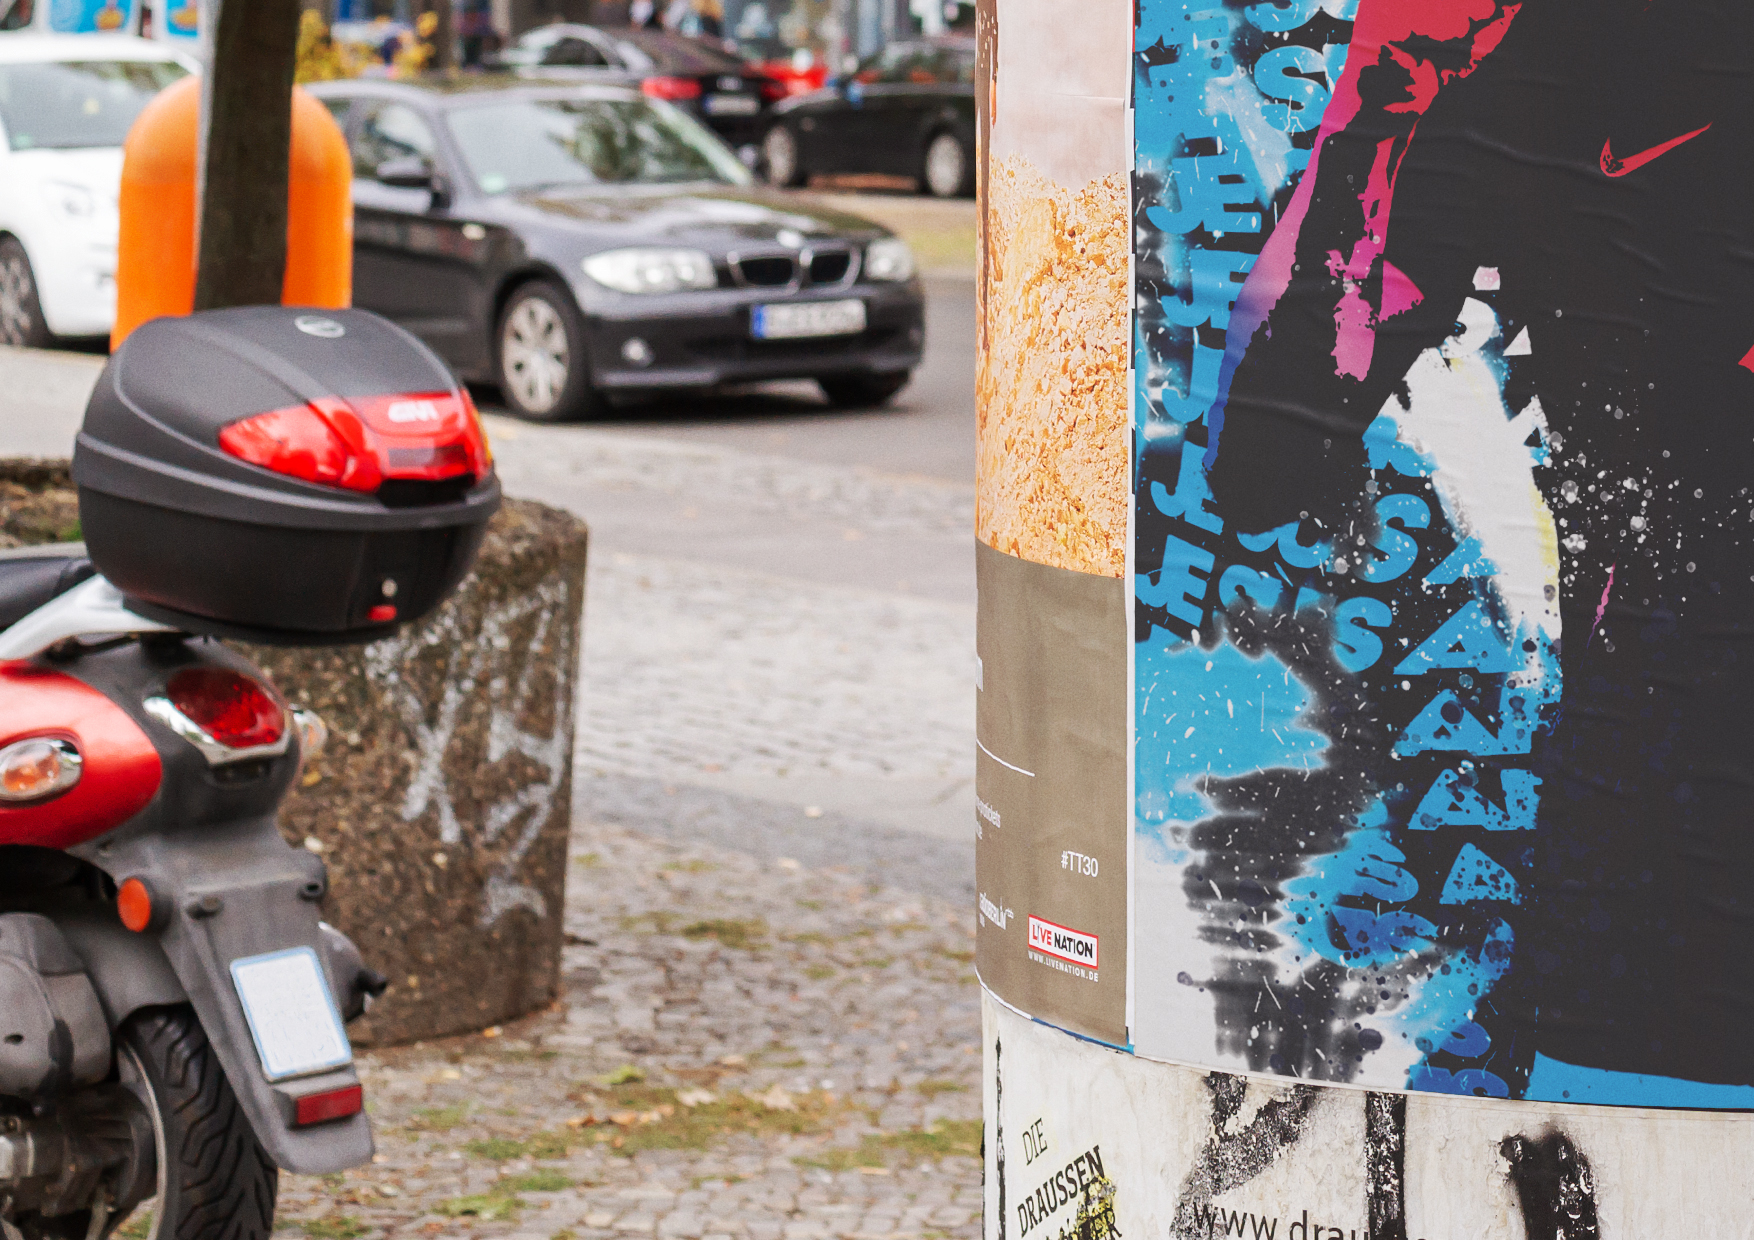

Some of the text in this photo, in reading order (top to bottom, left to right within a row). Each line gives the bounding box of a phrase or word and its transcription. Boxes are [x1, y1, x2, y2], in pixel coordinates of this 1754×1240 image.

[1060, 850, 1099, 878] #TT30
[1031, 922, 1094, 959] LIVE NATION
[1028, 949, 1099, 983] WWW.LIVENATION.DE
[1021, 1117, 1048, 1166] DIE
[1017, 1144, 1105, 1239] DRAUSSEN
